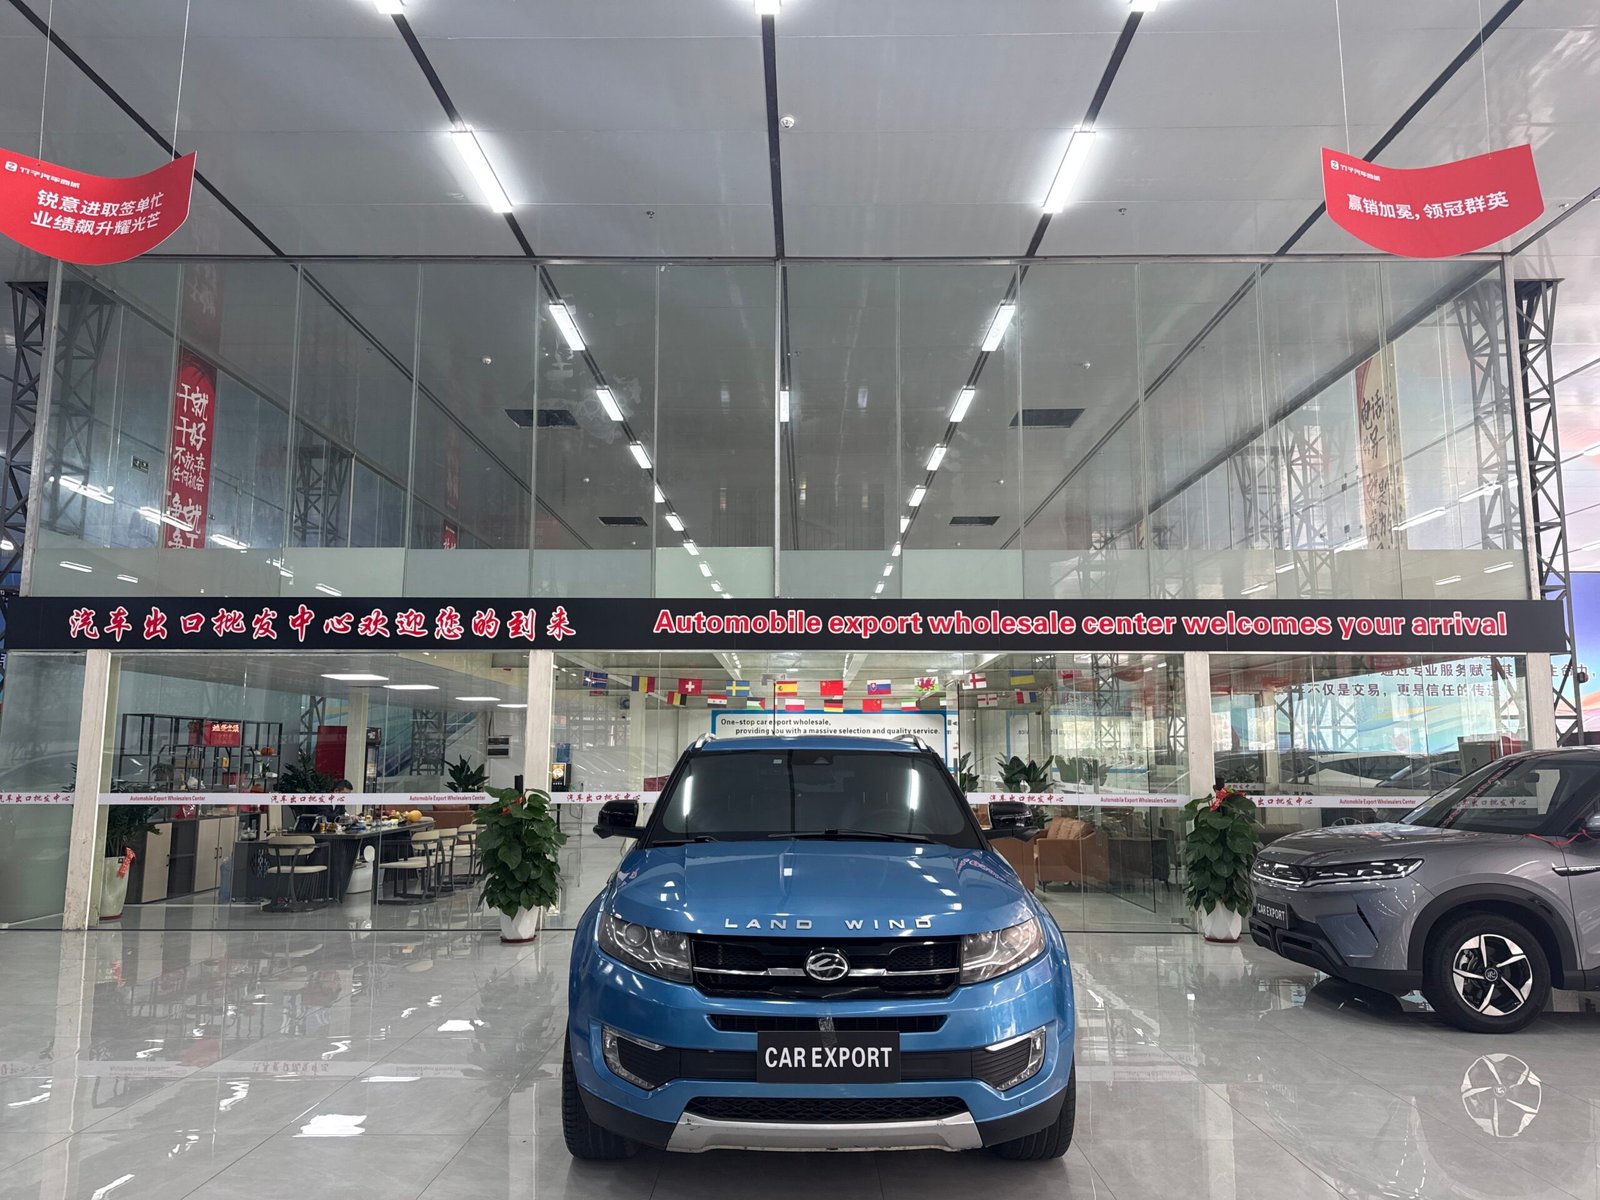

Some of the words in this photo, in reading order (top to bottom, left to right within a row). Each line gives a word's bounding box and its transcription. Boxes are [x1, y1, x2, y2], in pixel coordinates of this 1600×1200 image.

[37, 189, 165, 217] 锐意进取签单忙
[30, 210, 161, 237] 业绩飙升耀光芒
[69, 604, 577, 642] 汽车出口批发中心欢迎您的到来
[653, 608, 823, 635] Automobile
[827, 611, 923, 639] export
[927, 609, 1077, 636] wholesale
[1080, 612, 1177, 636] center
[1180, 610, 1333, 637] welcomes
[1336, 615, 1407, 640] your
[1410, 611, 1508, 637] arrival
[793, 718, 831, 726] wholesale,
[735, 728, 769, 736] providing
[886, 727, 911, 736] quality
[912, 727, 941, 735] service.
[271, 795, 346, 804] 汽车出口批发中心
[1249, 796, 1313, 806] 出口批发中心
[1266, 905, 1285, 921] EXPORT
[724, 918, 813, 930] LAND
[844, 918, 933, 930] WIND
[765, 1047, 806, 1068] CAR
[811, 1047, 893, 1068] EXPORT
